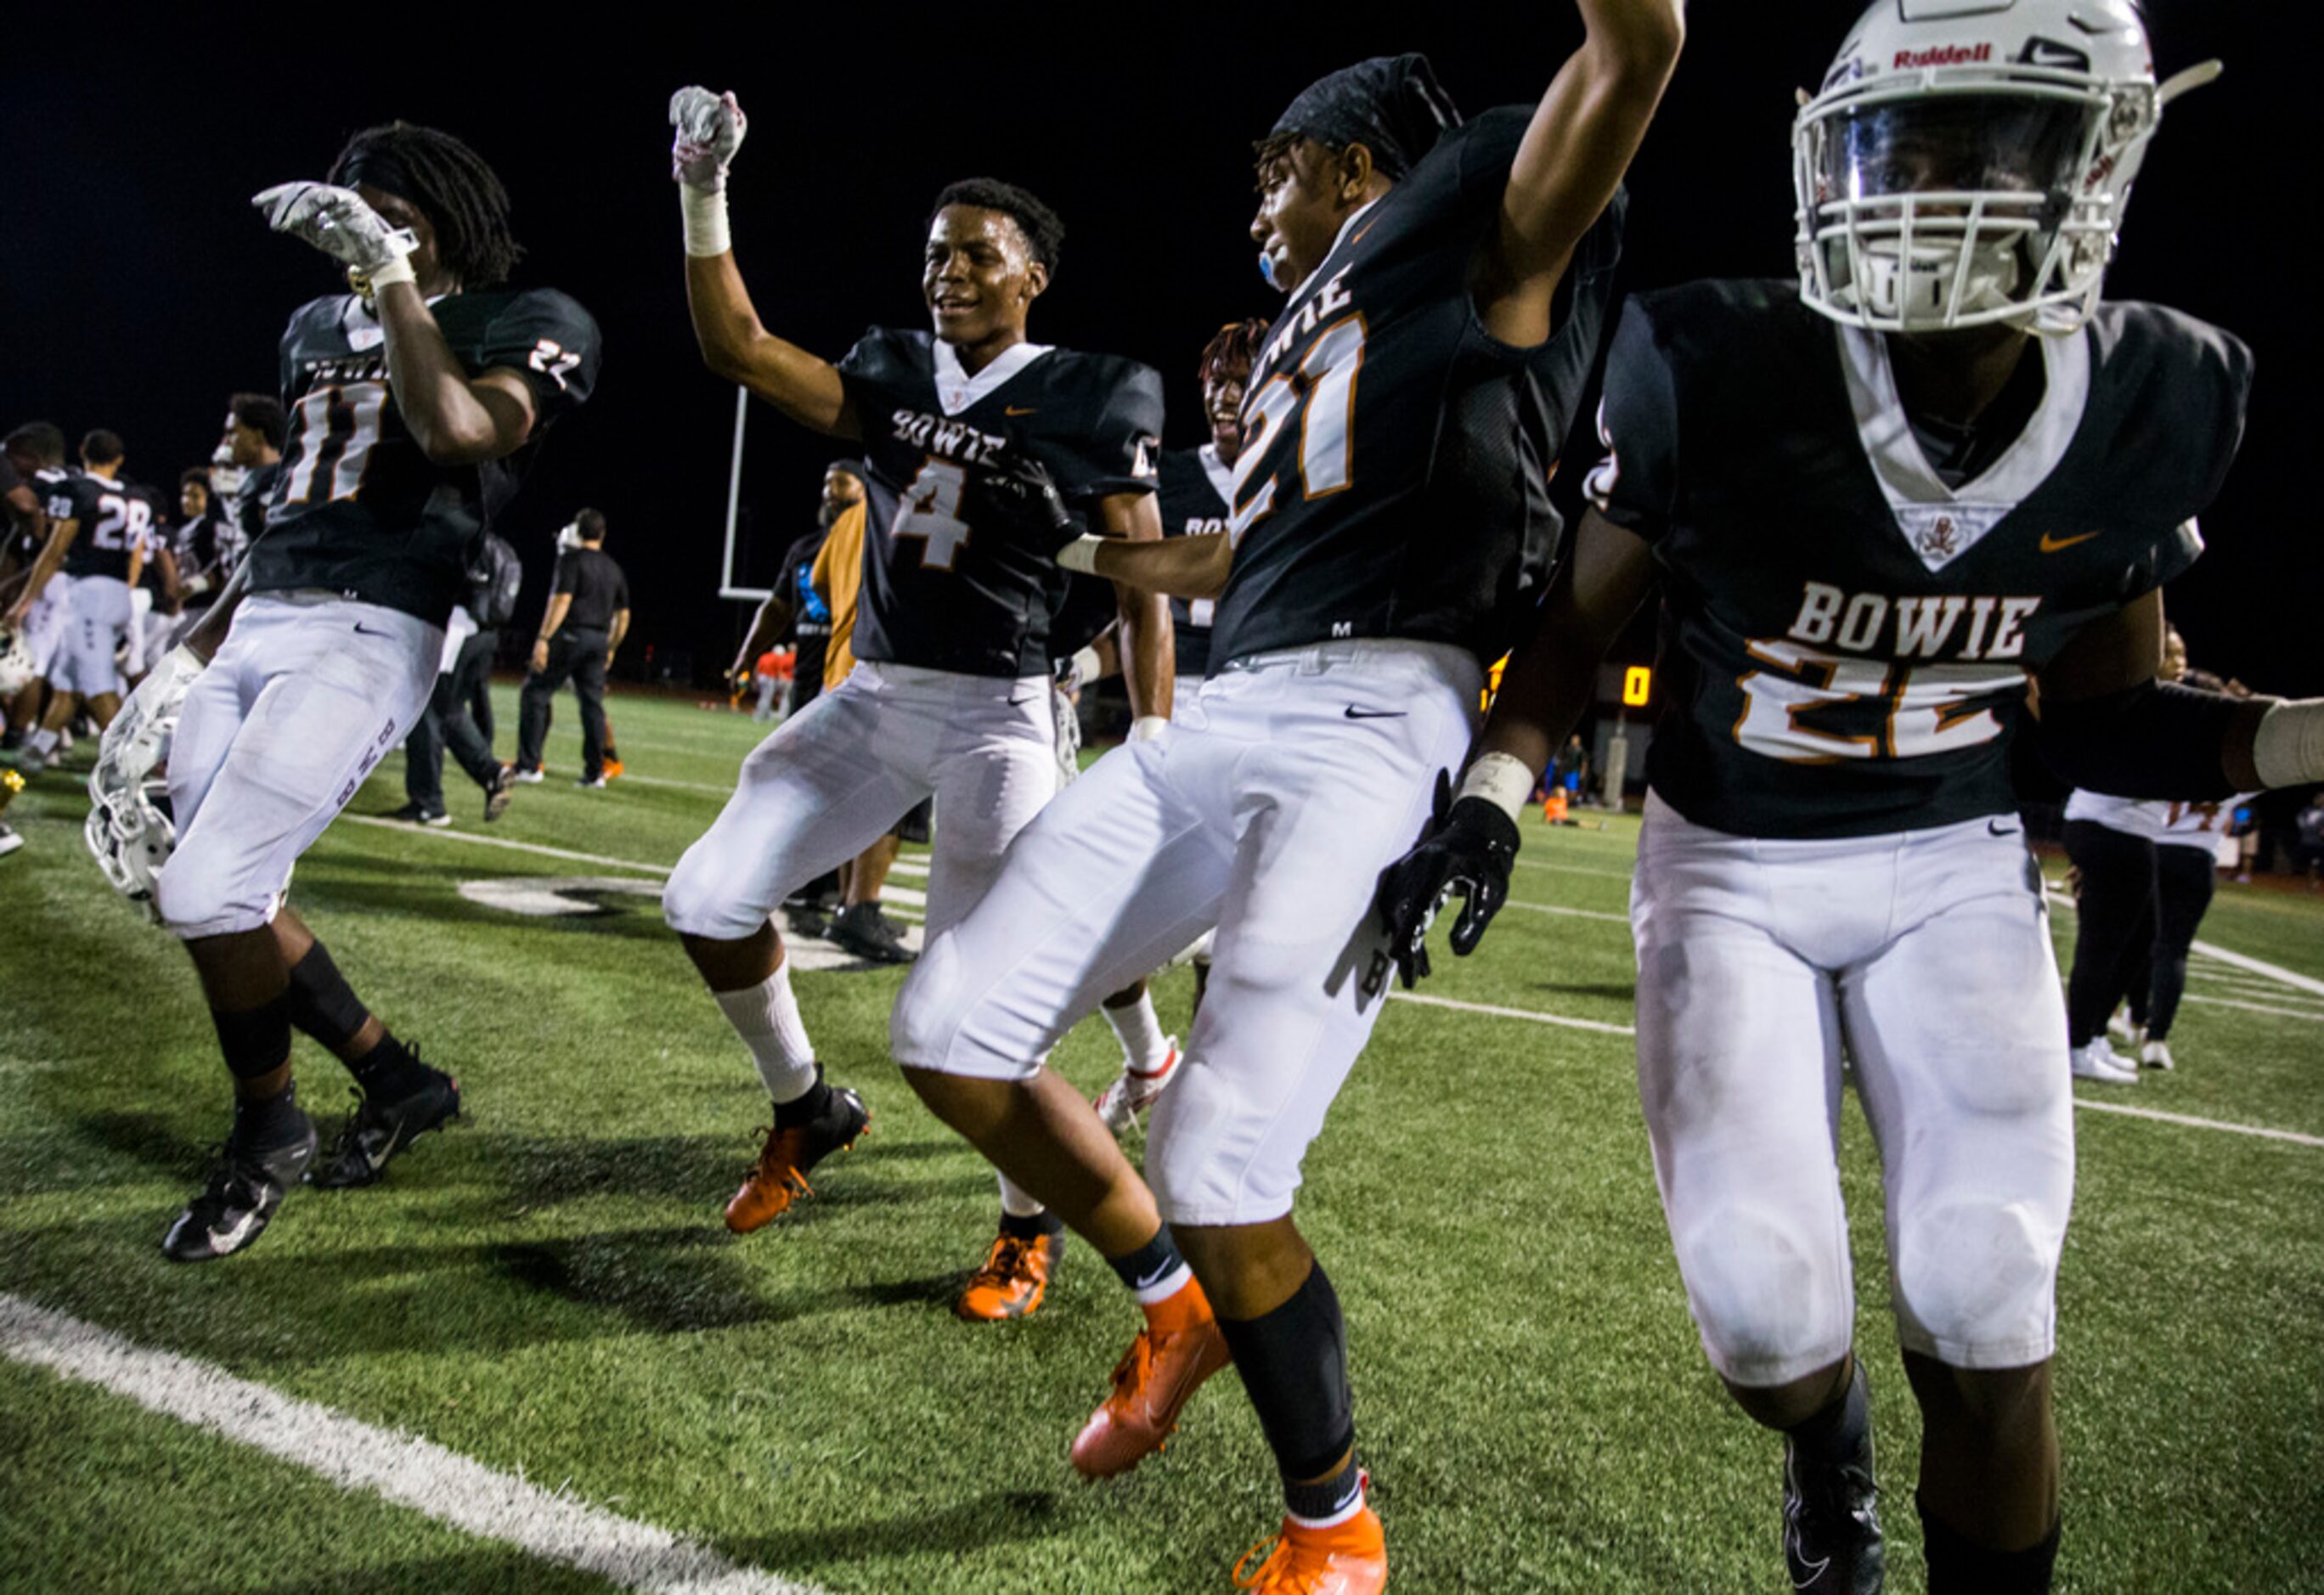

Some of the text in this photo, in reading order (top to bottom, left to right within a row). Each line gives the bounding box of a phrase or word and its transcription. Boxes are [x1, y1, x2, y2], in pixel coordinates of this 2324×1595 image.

[1892, 42, 1992, 69] Riddell
[287, 384, 387, 503] 11
[891, 409, 1007, 469] BOWIE
[1229, 309, 1368, 550] 21
[93, 493, 152, 552] 28
[891, 455, 971, 572] 4
[1331, 621, 1352, 638] M
[1788, 580, 2040, 659] BOWIE
[1623, 666, 1650, 707] 0
[1733, 638, 2032, 764] 22
